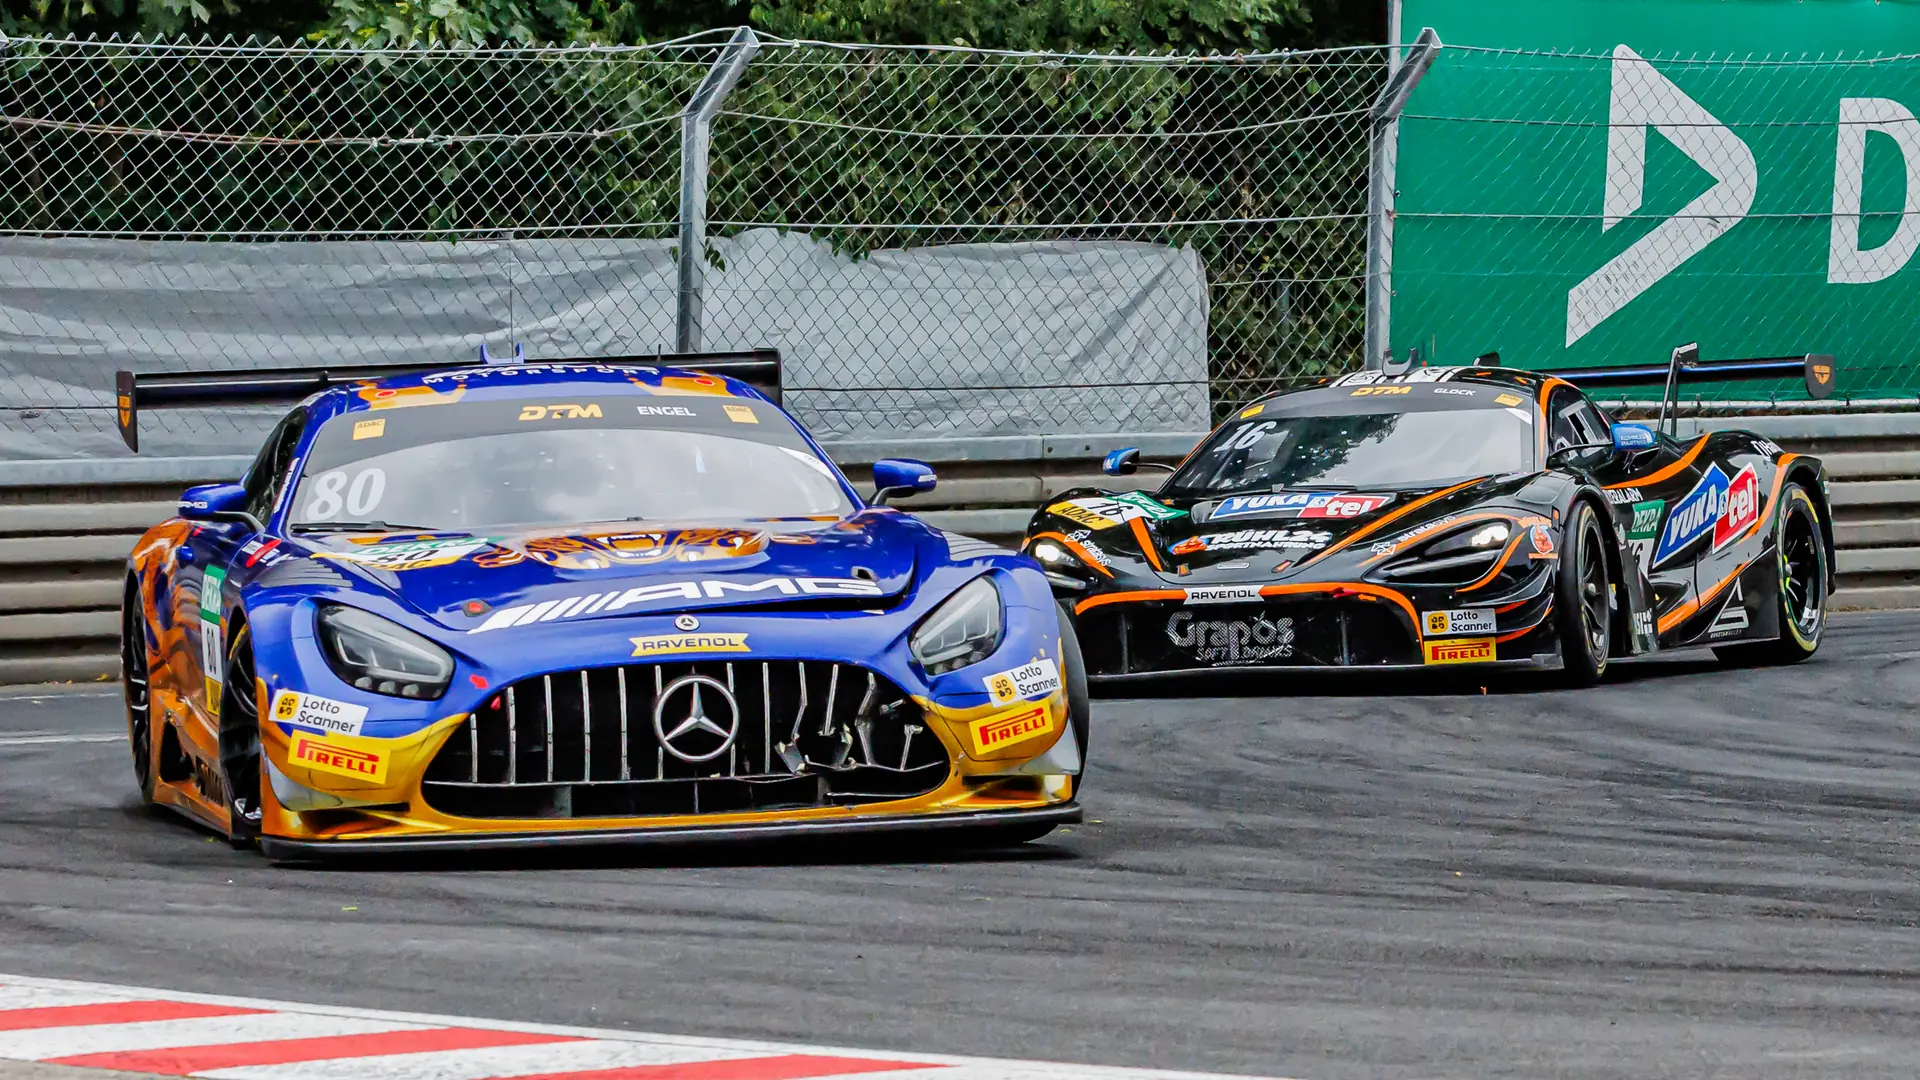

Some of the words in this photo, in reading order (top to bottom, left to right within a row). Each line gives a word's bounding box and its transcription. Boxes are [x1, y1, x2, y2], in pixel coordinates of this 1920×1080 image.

[422, 368, 660, 384] MOTORSPORT
[1350, 385, 1412, 396] DTM
[1434, 387, 1476, 396] GLOCK
[518, 404, 603, 421] DTM
[637, 406, 697, 417] ENGEL
[1212, 421, 1277, 453] 16
[305, 468, 386, 522] 80
[1230, 494, 1307, 510] YUKA
[1728, 478, 1756, 528] tel
[1325, 500, 1373, 516] tel
[1668, 484, 1718, 547] YUKA
[1204, 541, 1326, 552] SPORTNAHRUNG
[606, 577, 885, 610] AMG
[1191, 590, 1255, 600] RAVENOL
[1450, 611, 1478, 621] Lotto
[1451, 620, 1492, 632] Scanner
[641, 636, 740, 652] RAVENOL
[1166, 611, 1294, 660] Grapos
[1431, 642, 1490, 660] PIRELLI
[1011, 665, 1042, 682] Lotto
[1018, 676, 1059, 696] Scanner
[302, 696, 340, 714] Lotto
[297, 710, 356, 732] Scanner
[979, 708, 1045, 745] PIRELLI
[297, 739, 379, 774] PIRELLI
